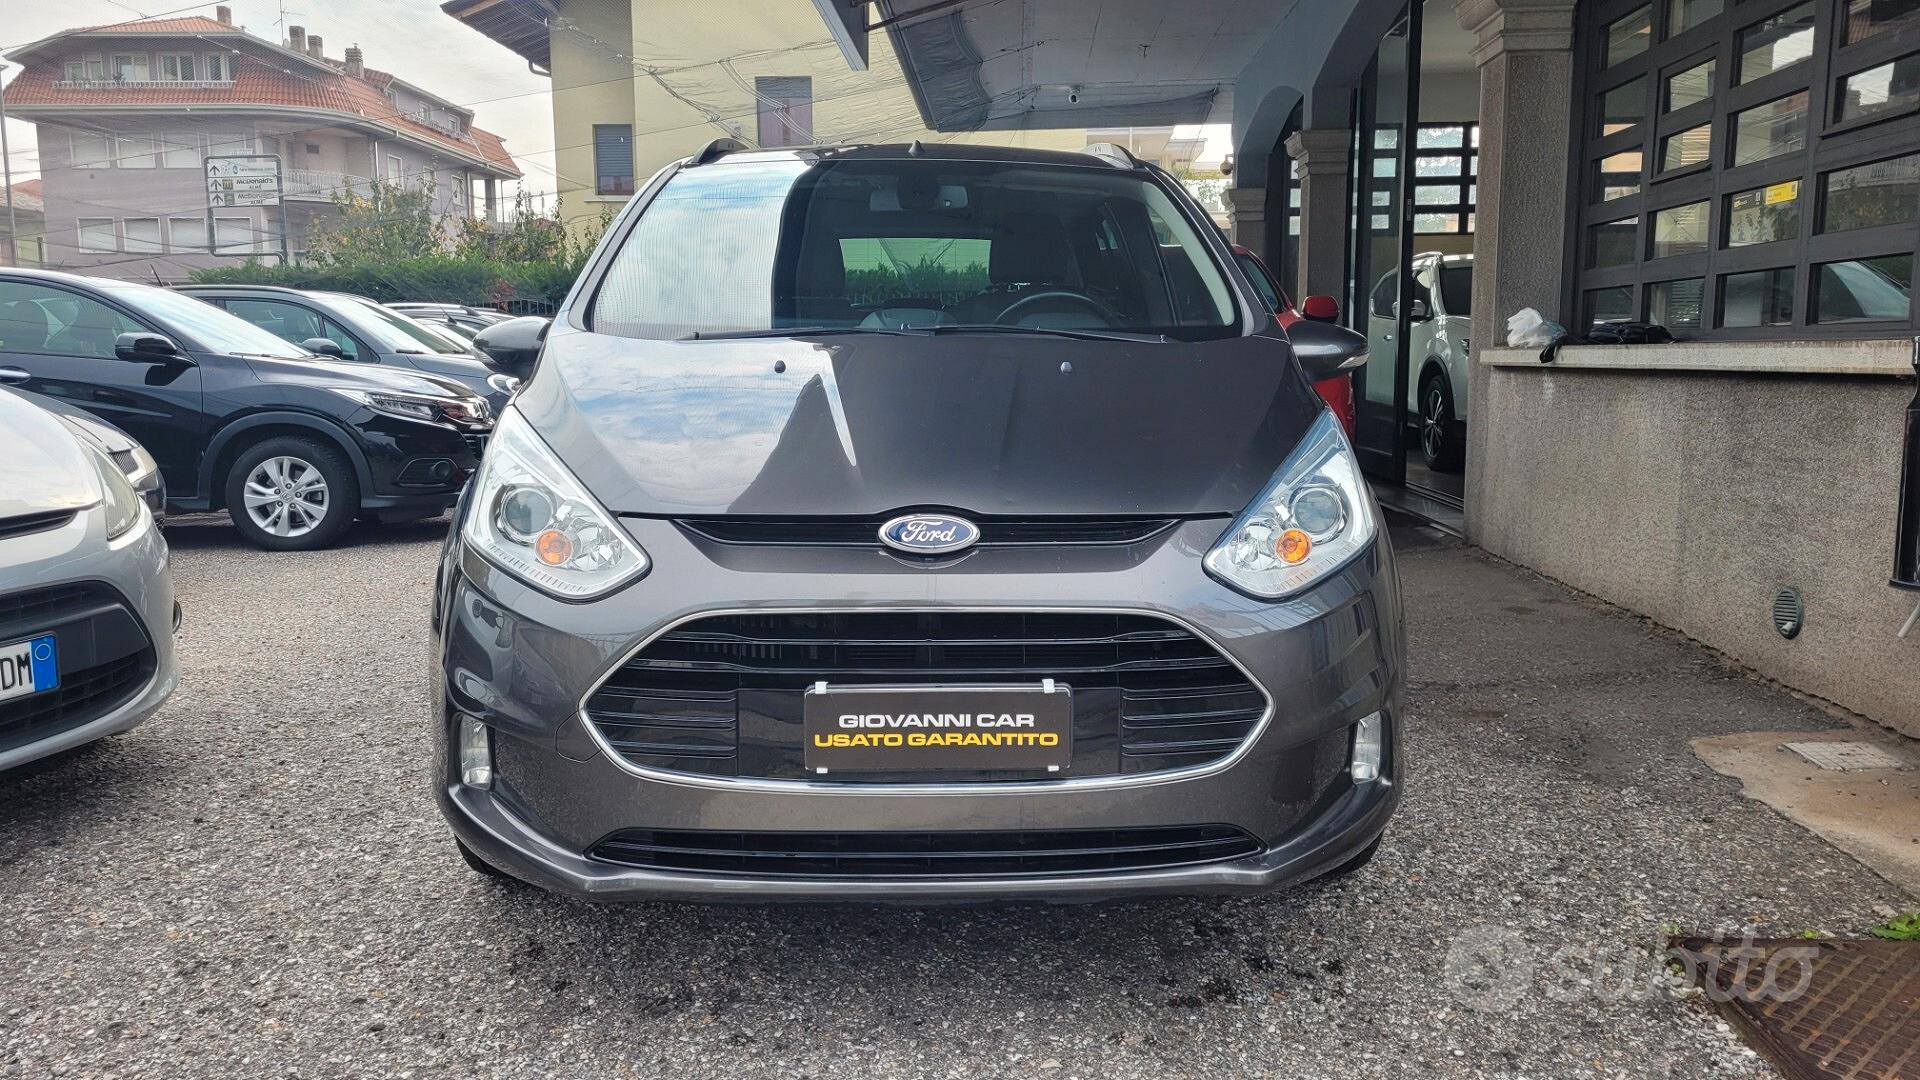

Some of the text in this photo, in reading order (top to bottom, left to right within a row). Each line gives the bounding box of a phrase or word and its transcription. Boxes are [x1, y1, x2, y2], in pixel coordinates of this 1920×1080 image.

[902, 520, 957, 542] Ford
[838, 713, 1035, 728] GIOVANNI CAR
[814, 732, 1059, 747] USATO GARANTITO
